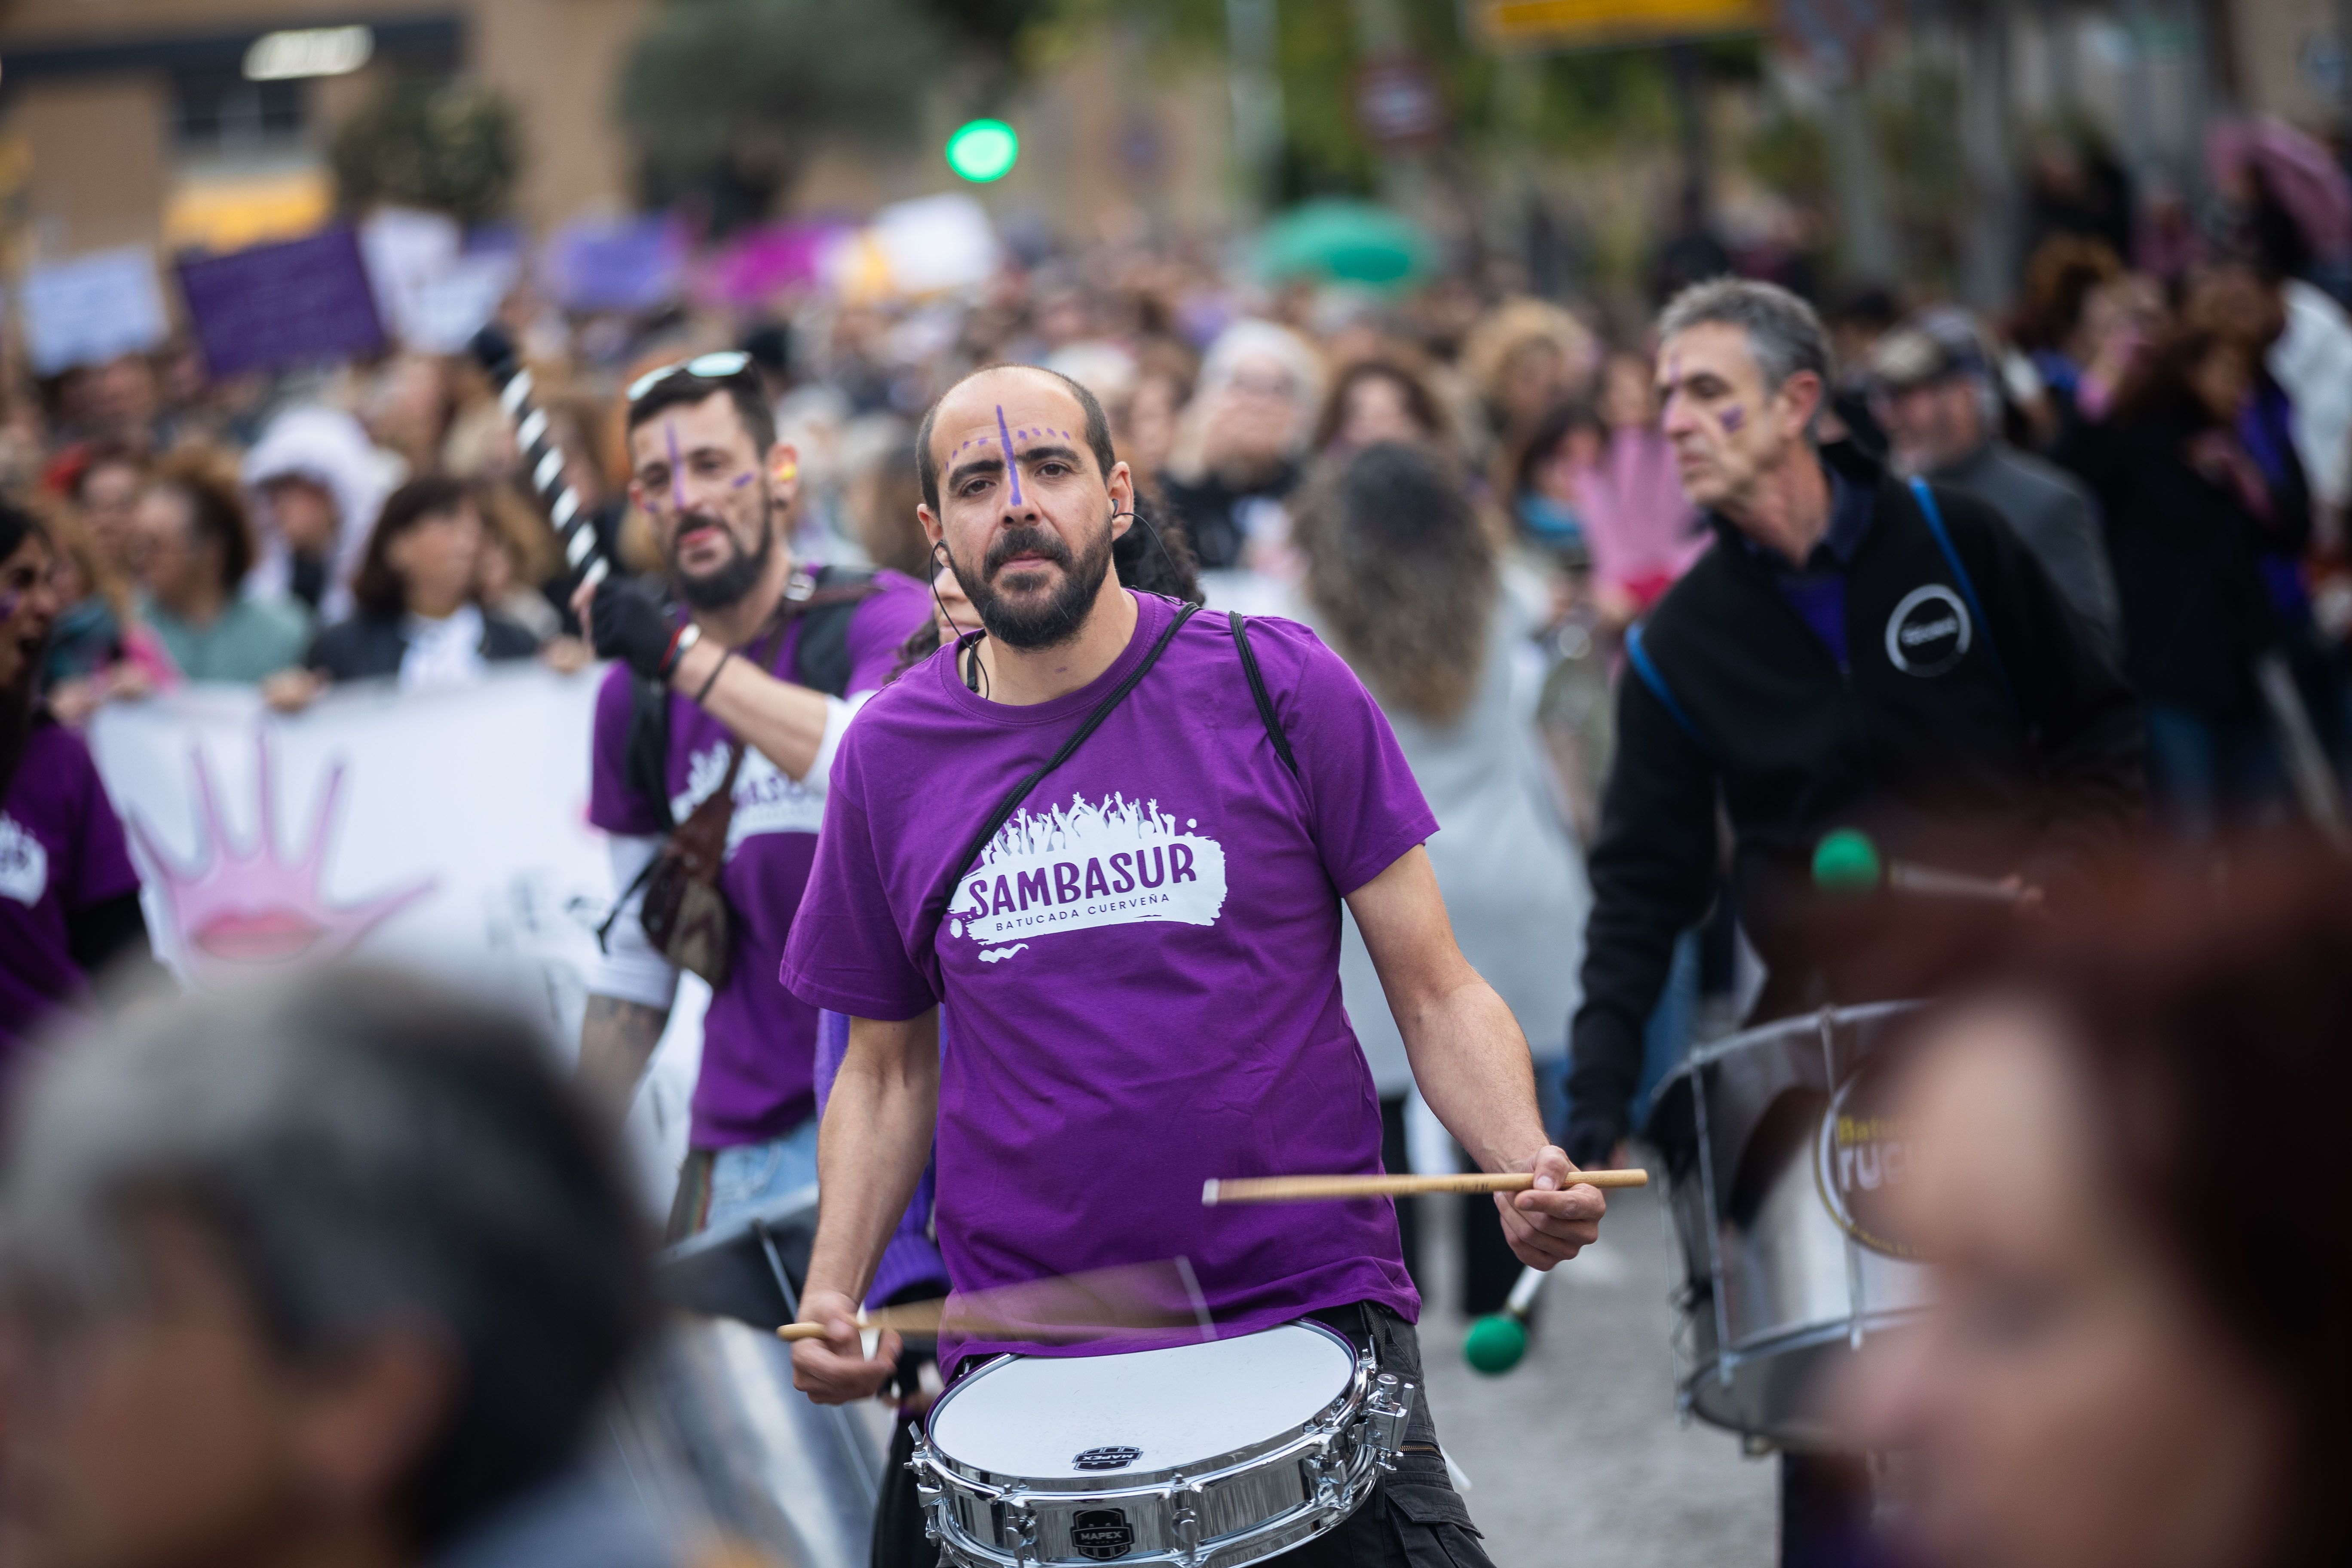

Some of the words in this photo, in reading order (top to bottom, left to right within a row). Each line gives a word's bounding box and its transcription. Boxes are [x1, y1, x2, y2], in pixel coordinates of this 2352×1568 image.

[969, 843, 1197, 919] SAMBASUR
[996, 909, 1080, 931] BATUCADA
[1087, 894, 1170, 915] CUERVEÑA
[1081, 1531, 1122, 1540] MAPEX
